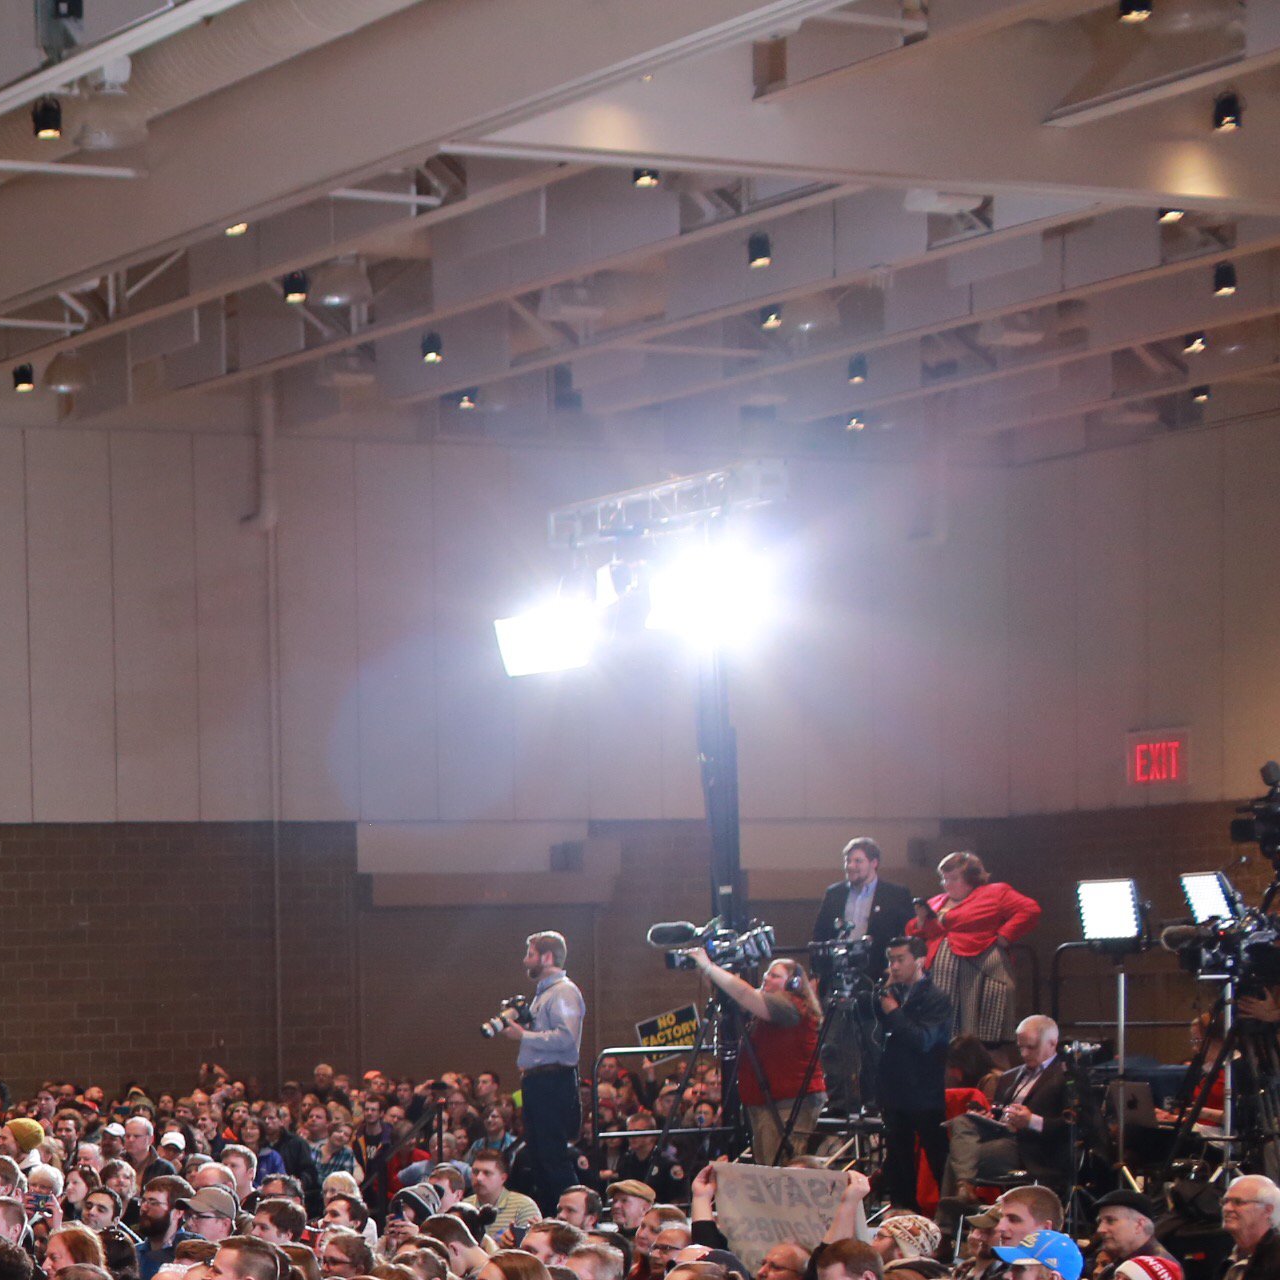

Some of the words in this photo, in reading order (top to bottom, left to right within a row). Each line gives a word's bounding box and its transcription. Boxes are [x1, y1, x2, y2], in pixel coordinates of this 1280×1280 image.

[1135, 741, 1179, 782] EXIT
[642, 1019, 698, 1046] FACTORY
[657, 1013, 676, 1029] NO
